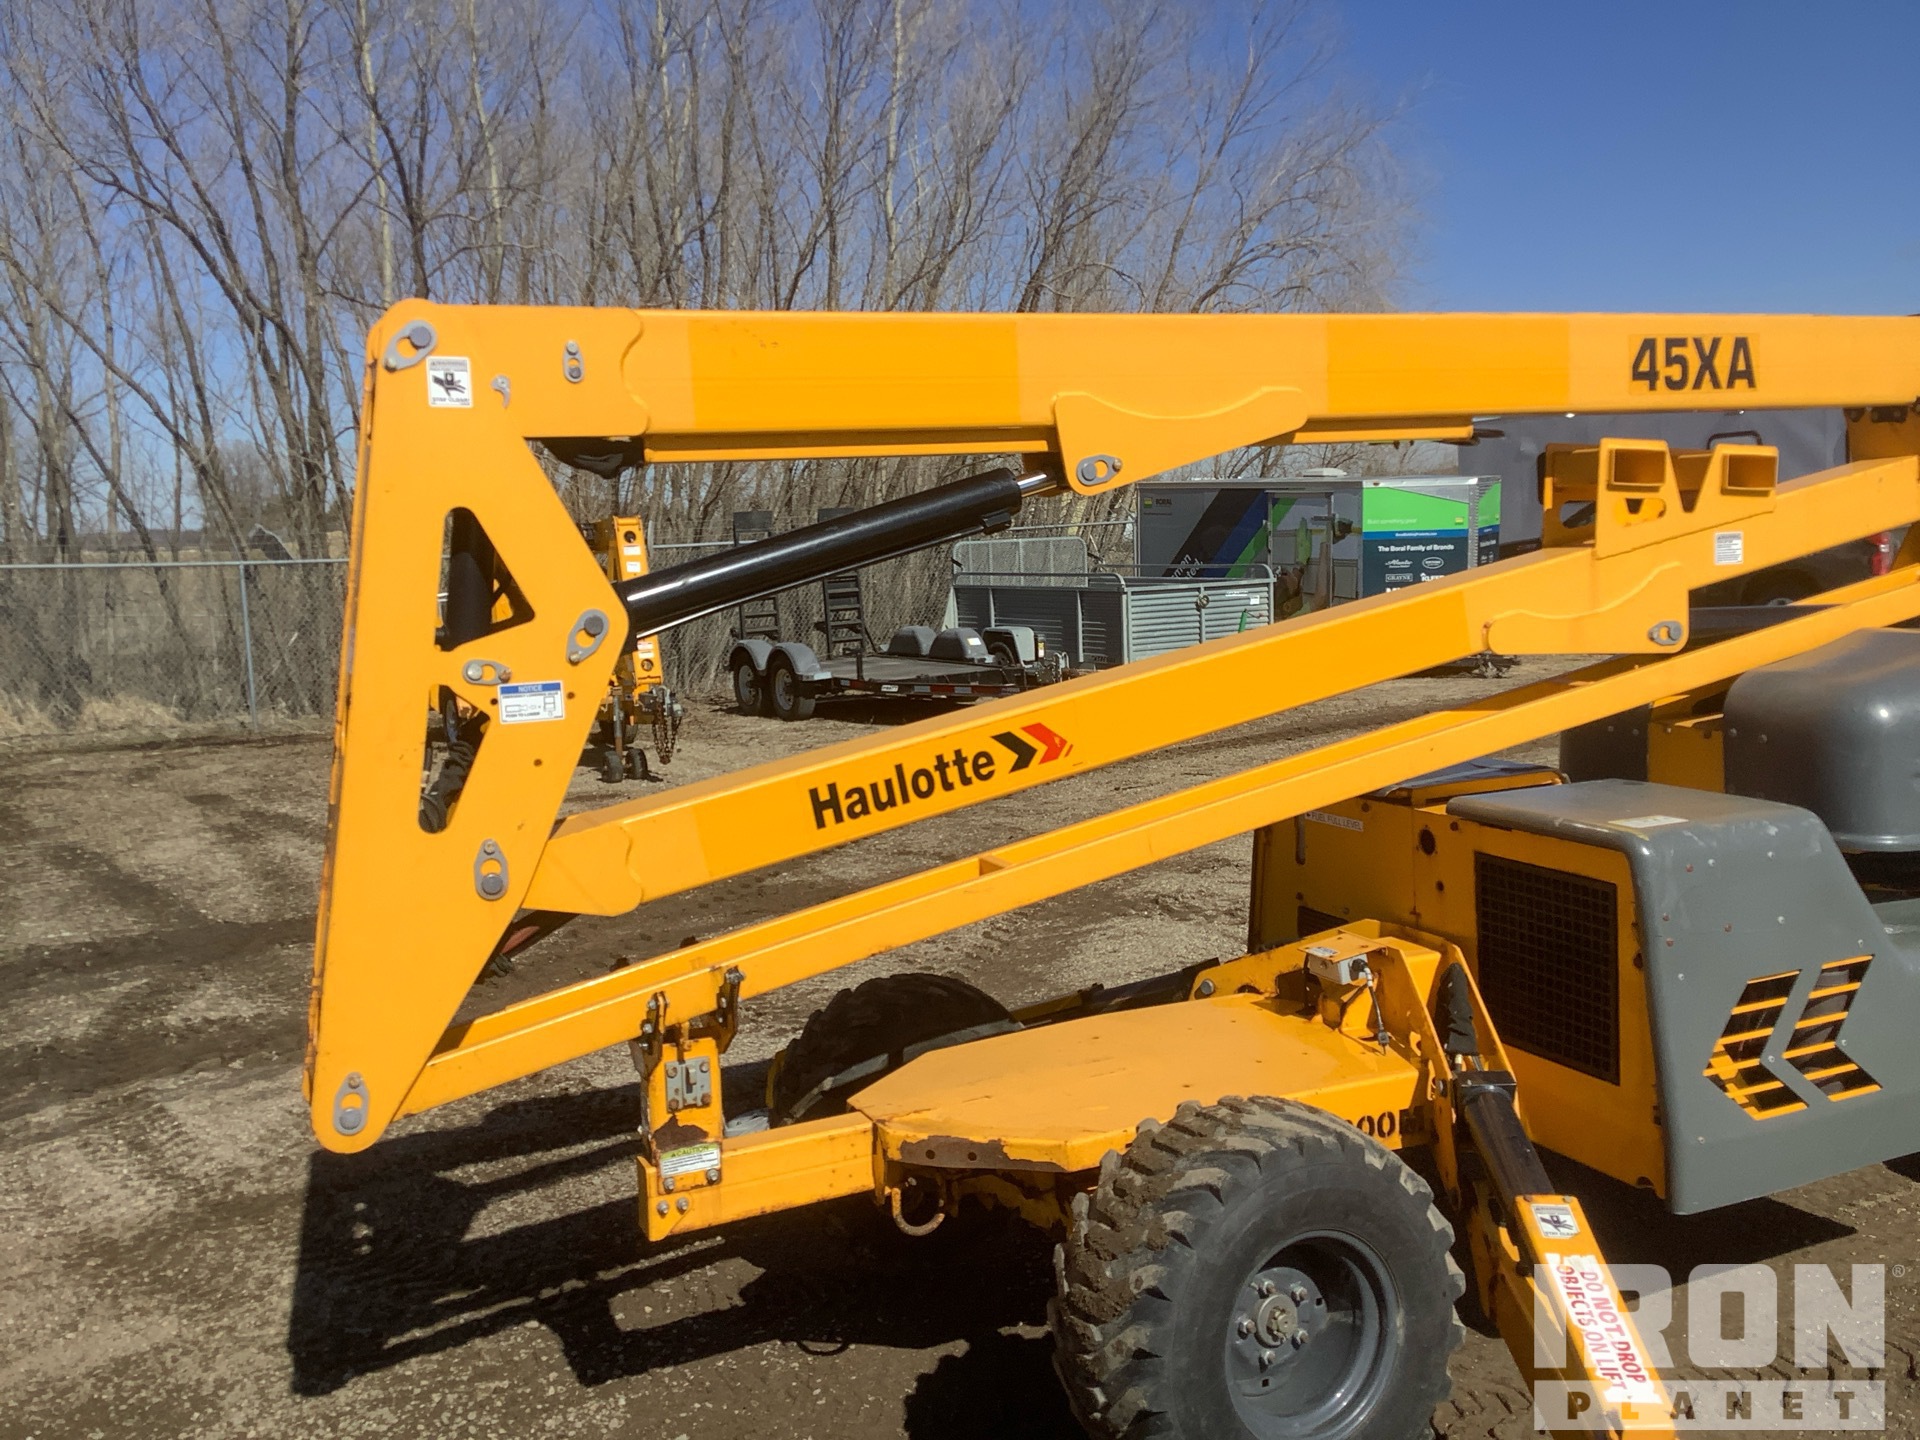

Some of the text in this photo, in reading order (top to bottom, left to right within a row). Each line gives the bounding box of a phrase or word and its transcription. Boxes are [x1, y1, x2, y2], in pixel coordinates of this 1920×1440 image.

[1631, 336, 1757, 391] 45XA
[1406, 544, 1426, 553] Family
[1433, 543, 1455, 551] Brands
[518, 684, 543, 693] NOTICE
[808, 748, 996, 830] Haulotte
[677, 1144, 709, 1157] CAUTION
[1556, 1265, 1628, 1390] OBJECTS ON LIFT
[1580, 1270, 1647, 1384] DO NOT DROP
